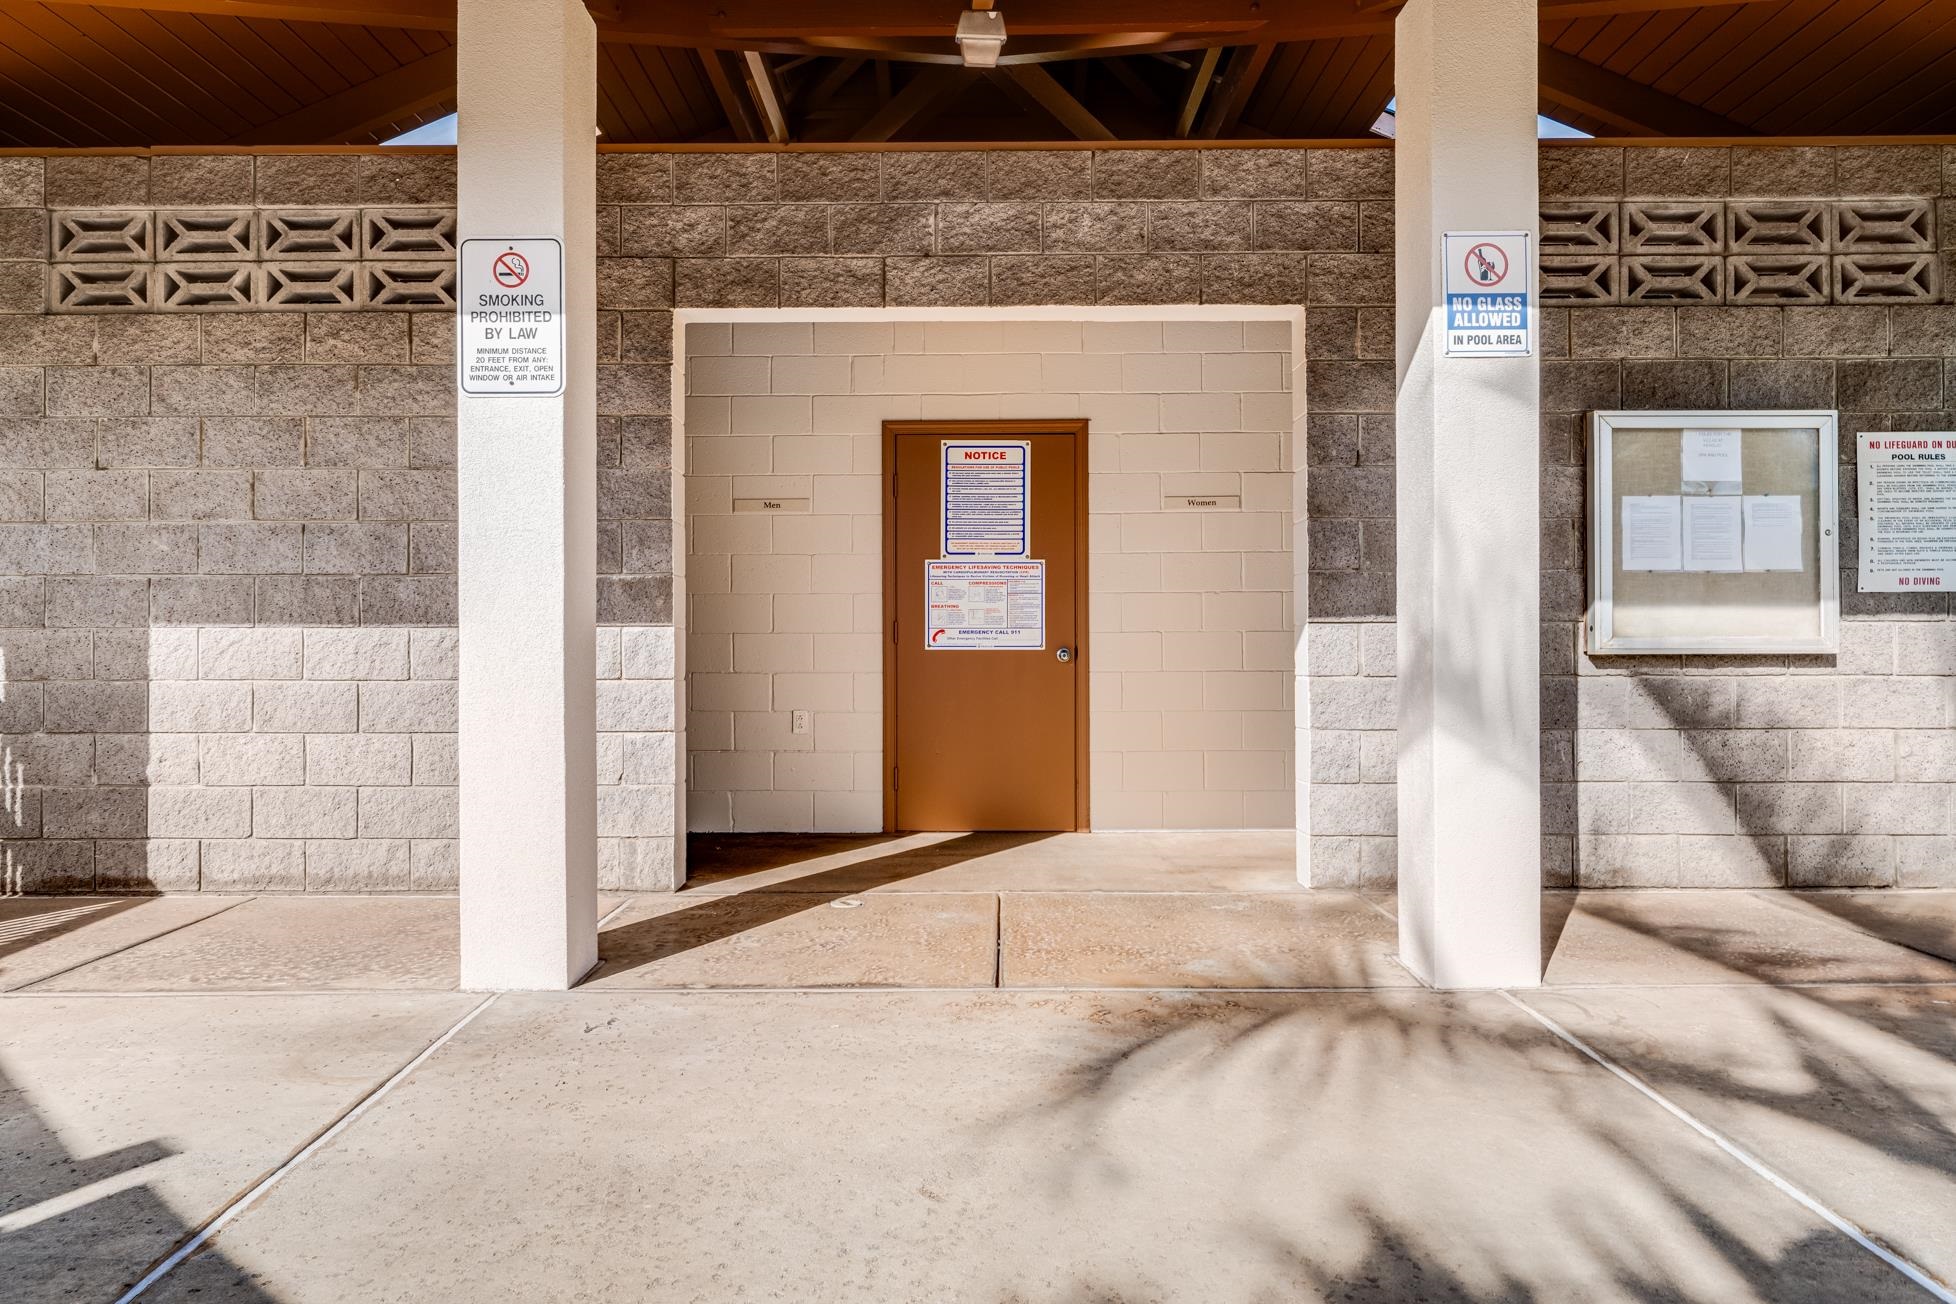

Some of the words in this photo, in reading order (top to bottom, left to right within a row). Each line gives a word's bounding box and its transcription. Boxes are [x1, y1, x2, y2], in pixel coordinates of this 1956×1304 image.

[478, 294, 544, 307] SMOKING
[1452, 296, 1473, 311] NO
[1477, 296, 1522, 311] GLASS
[470, 311, 552, 323] PROHIBITED
[1454, 312, 1521, 327] ALLOWED
[485, 328, 502, 340] BY
[509, 328, 538, 340] LAW
[1453, 335, 1464, 345] IN
[1467, 335, 1493, 345] POOL
[1496, 335, 1522, 345] AREA
[476, 356, 485, 364] 20
[488, 356, 506, 364] FEET
[508, 356, 529, 364] FROM
[532, 356, 548, 364] ANY:
[1869, 440, 1881, 449] NO
[1884, 440, 1928, 449] LIFEGUARD
[1932, 440, 1943, 449] ON
[964, 452, 1007, 460] NOTICE
[1898, 577, 1910, 586] NO
[1913, 577, 1940, 586] DIVING
